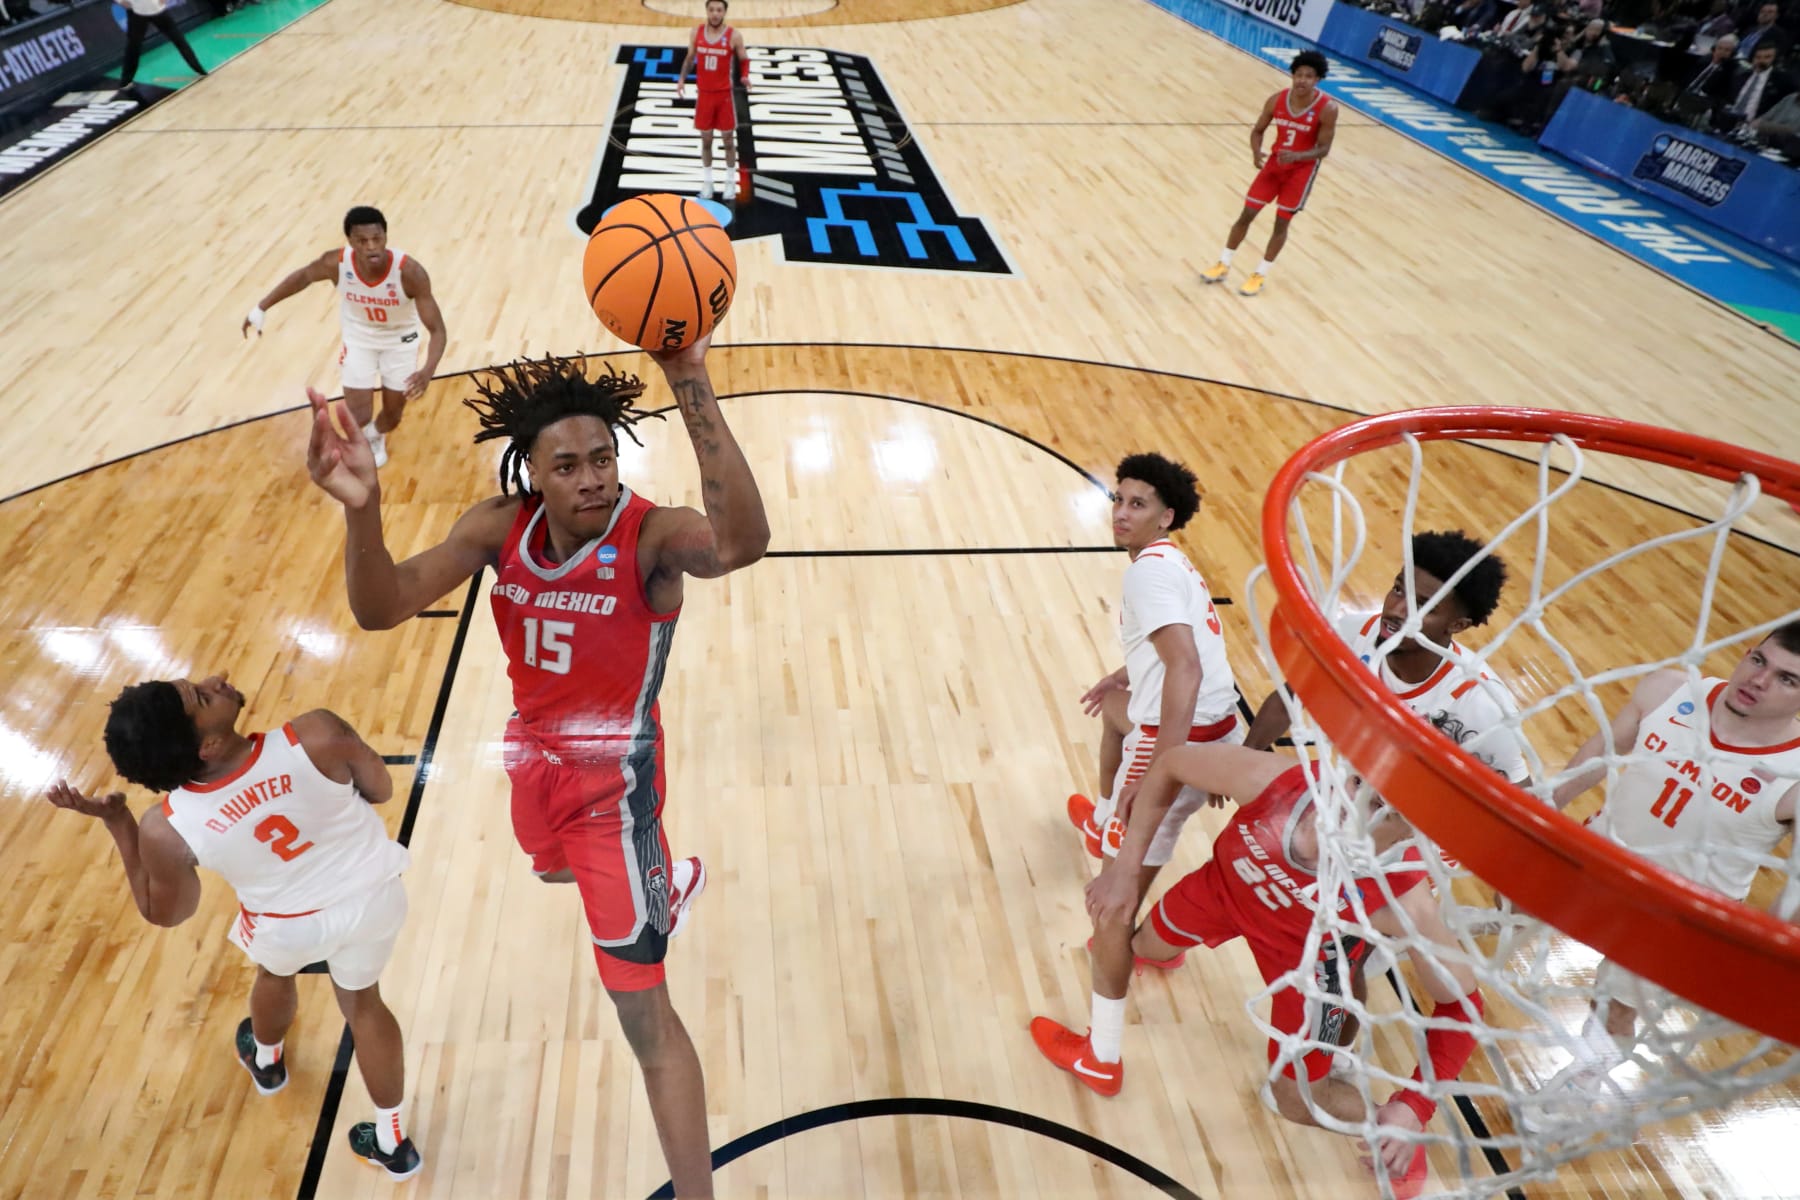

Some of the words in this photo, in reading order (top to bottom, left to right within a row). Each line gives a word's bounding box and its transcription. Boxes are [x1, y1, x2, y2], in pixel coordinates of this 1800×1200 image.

[704, 55, 718, 71] 10
[745, 47, 877, 176] MADNESS
[1337, 85, 1489, 134] FINAL
[618, 81, 741, 193] MARCH
[1282, 129, 1297, 146] 3
[1663, 140, 1720, 174] MARCH
[1461, 147, 1667, 218] ROAD
[1661, 161, 1732, 202] MADNESS
[1598, 219, 1732, 263] THE
[345, 291, 400, 307] CLEMSON
[364, 306, 388, 323] 10
[493, 583, 531, 606] NEW
[534, 590, 618, 616] MEXICO
[522, 617, 576, 676] 15
[1643, 731, 1753, 815] CLMON
[1649, 776, 1695, 830] 11
[253, 814, 316, 863] 2
[1238, 823, 1270, 861] NEW
